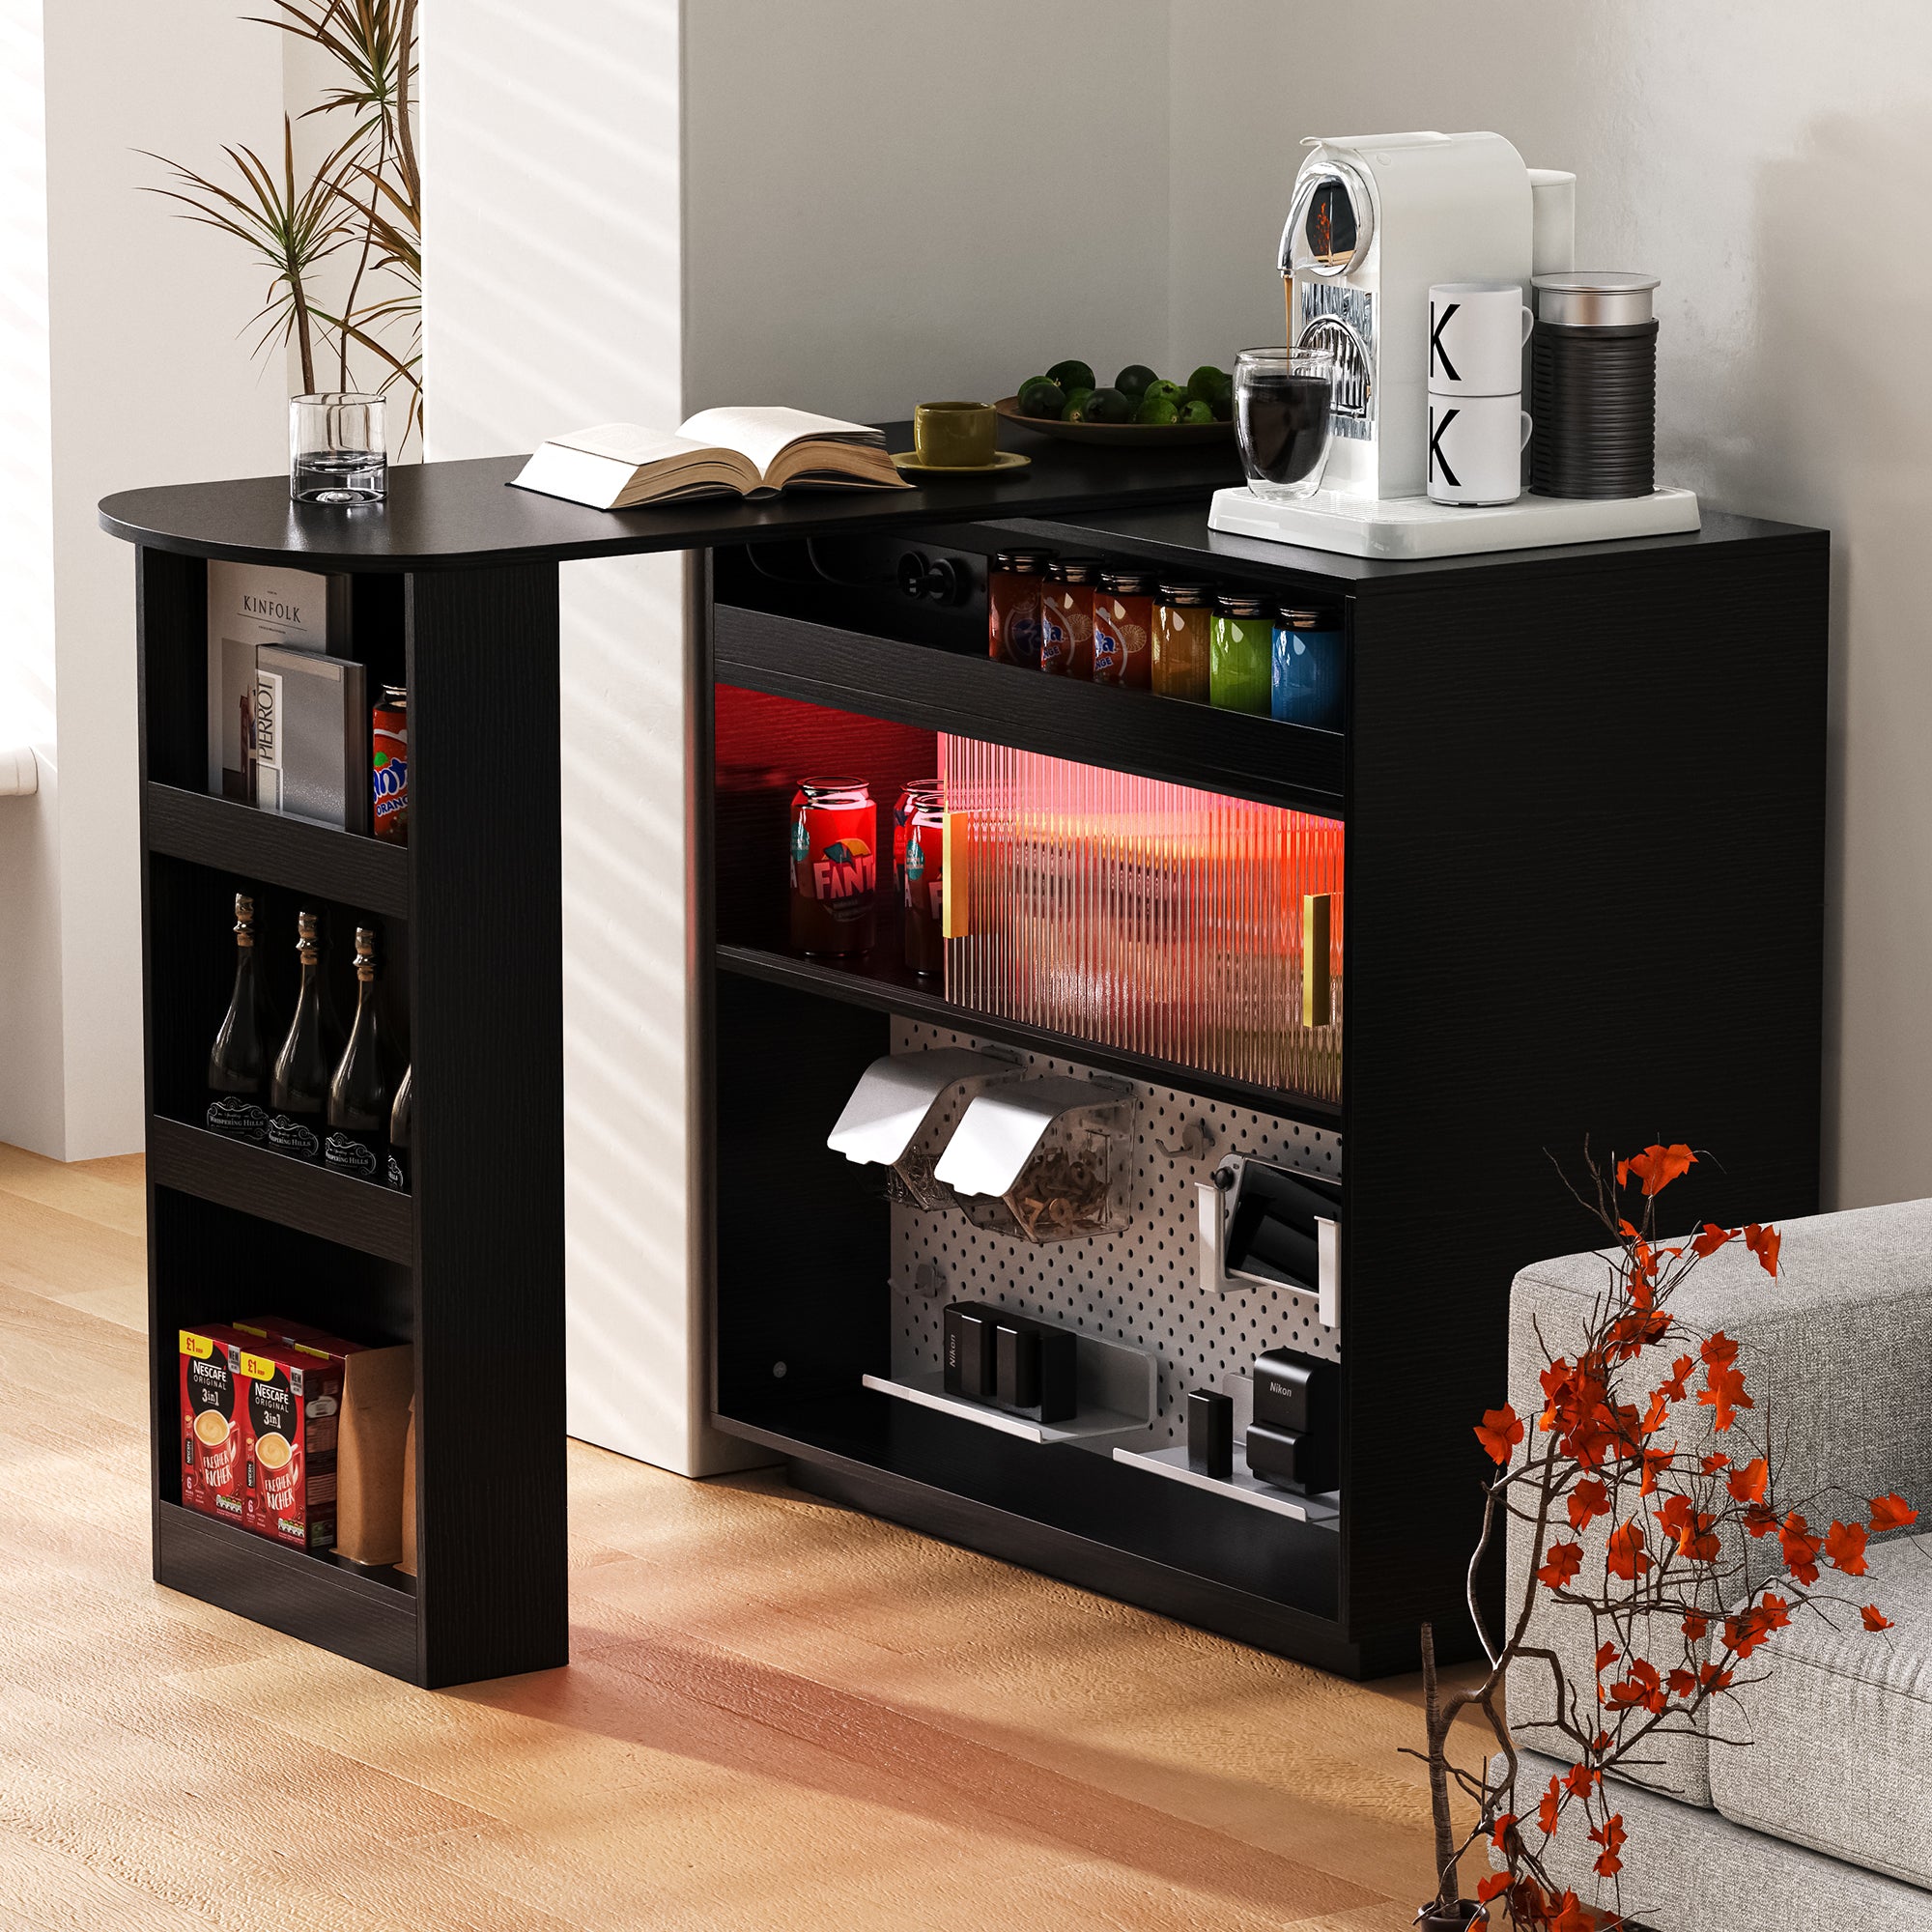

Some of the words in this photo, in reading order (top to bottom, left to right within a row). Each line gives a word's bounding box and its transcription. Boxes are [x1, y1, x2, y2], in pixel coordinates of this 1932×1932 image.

[1430, 300, 1462, 382] K
[1429, 406, 1462, 487] K
[243, 595, 300, 623] KINFOLK
[259, 682, 273, 761] PIERROT
[377, 794, 408, 817] ORANG
[193, 1375, 227, 1390] ORIGINAL
[1269, 1380, 1293, 1398] Nikon
[202, 1388, 219, 1406] 3in1
[255, 1397, 289, 1413] ORIGINAL
[264, 1410, 281, 1429] 3in1
[203, 1451, 229, 1469] FRESHER
[186, 1477, 192, 1490] 6
[205, 1465, 233, 1488] RICHER
[265, 1473, 292, 1492] FRESHER
[247, 1499, 254, 1513] 6
[267, 1489, 295, 1511] RICHER
